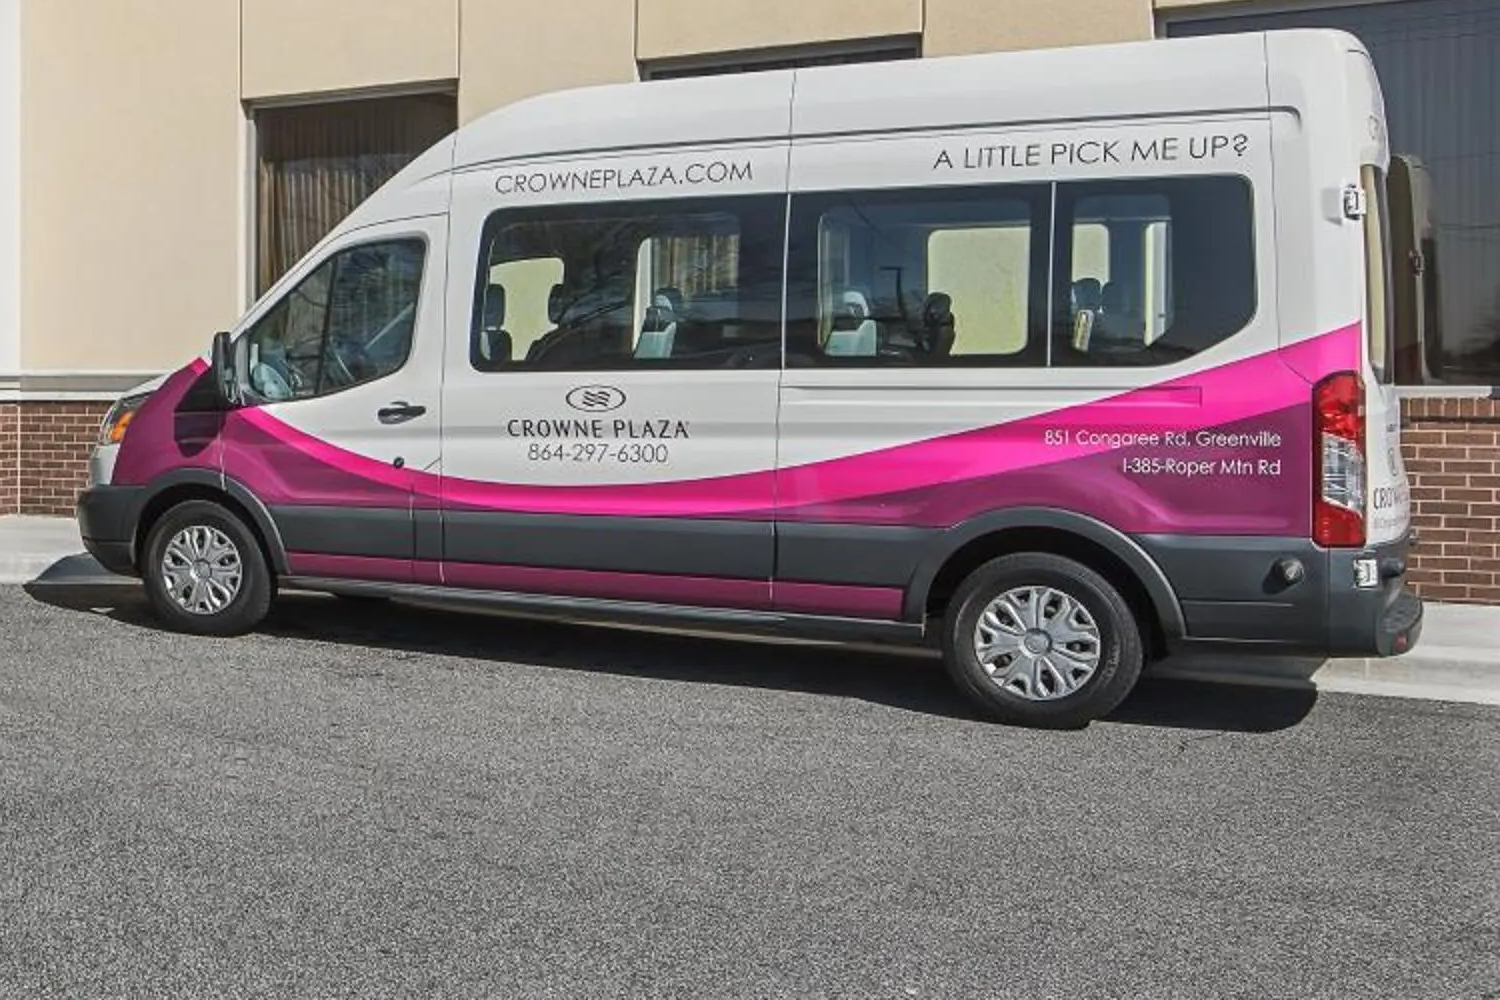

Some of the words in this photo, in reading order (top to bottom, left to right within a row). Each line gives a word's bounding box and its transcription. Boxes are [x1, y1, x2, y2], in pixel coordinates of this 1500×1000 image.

[933, 150, 953, 170] A
[963, 144, 1041, 169] LITTLE
[1050, 140, 1121, 165] PICK
[1131, 137, 1179, 161] ME
[1188, 133, 1250, 159] UP?
[494, 161, 754, 195] CROWNEPLAZA.COM
[506, 418, 604, 439] CROWNE
[612, 419, 689, 439] PLAZA
[1044, 430, 1070, 446] 851
[1075, 430, 1160, 449] Congaree
[1195, 430, 1282, 448] Greenville
[528, 443, 669, 463] 864-297-6300
[1219, 459, 1252, 475] Mtn
[1257, 459, 1281, 476] Rd
